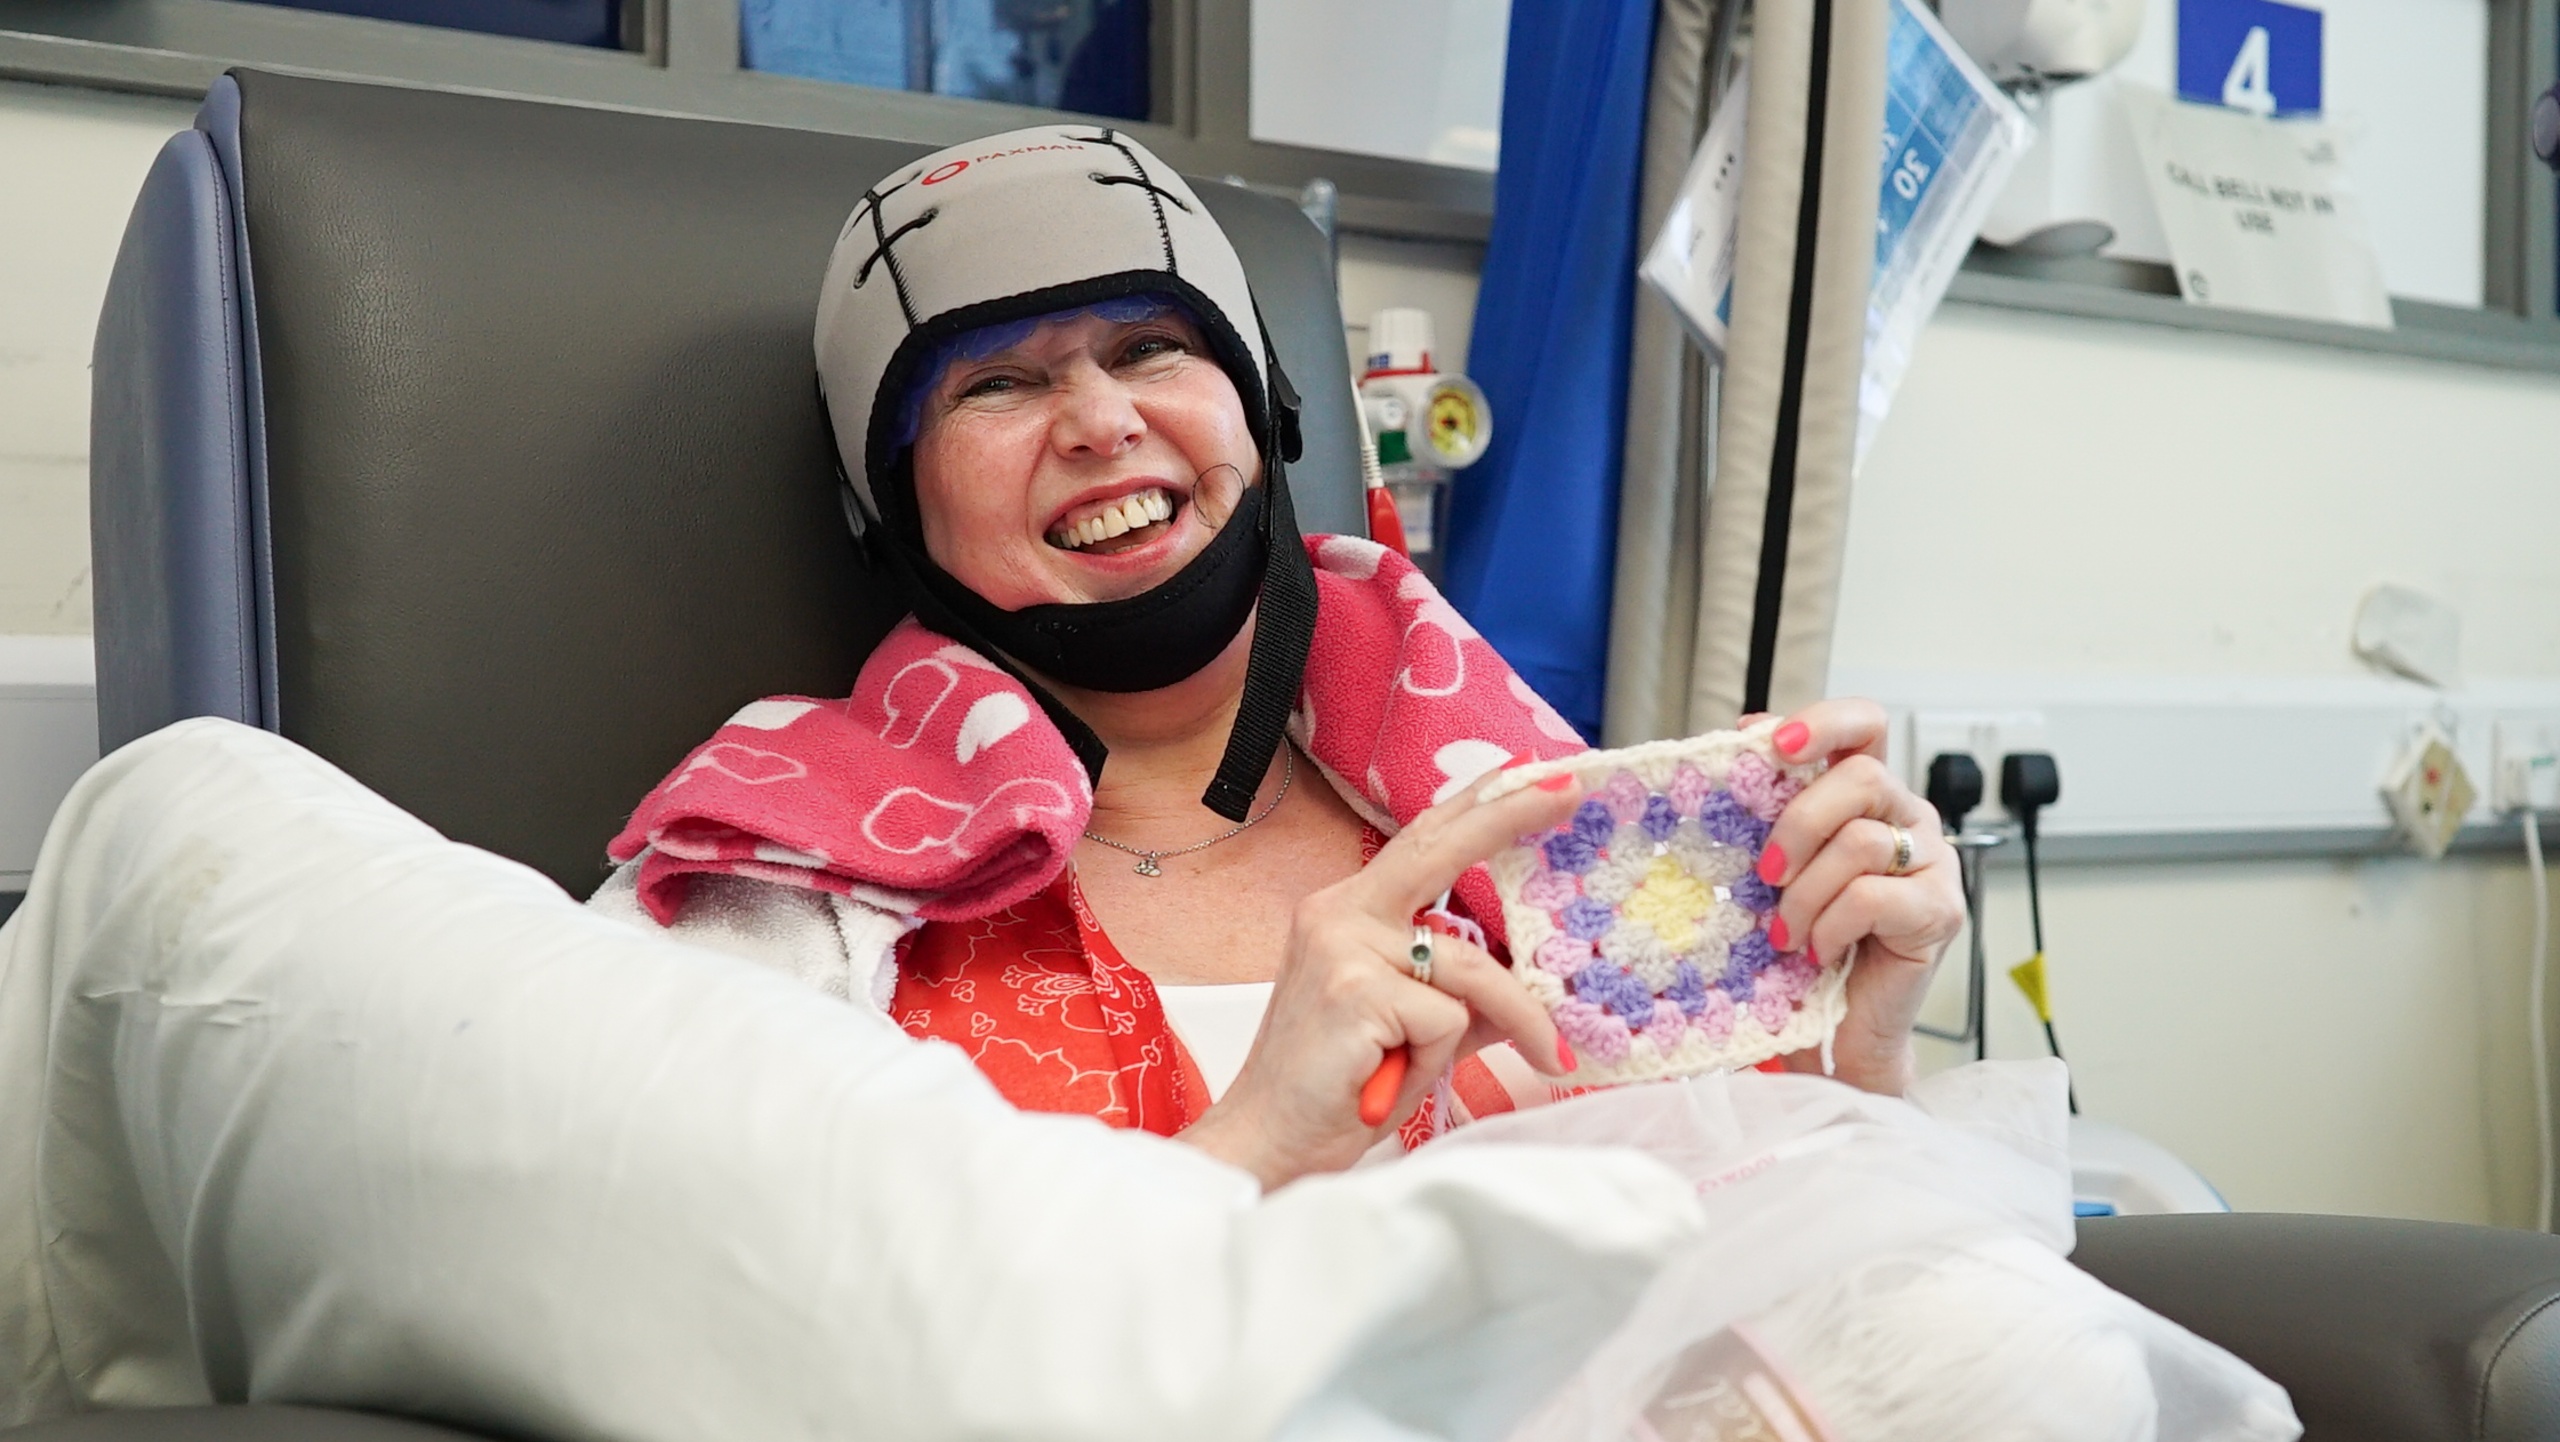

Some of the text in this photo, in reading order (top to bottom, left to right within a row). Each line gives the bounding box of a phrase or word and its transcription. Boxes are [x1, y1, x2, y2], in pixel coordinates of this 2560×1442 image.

[2222, 25, 2277, 113] 4
[976, 144, 1084, 163] PAXMAN
[2165, 161, 2210, 195] CALL
[2213, 175, 2265, 202] BELL
[2267, 187, 2304, 212] NOT
[2235, 209, 2275, 236] USE
